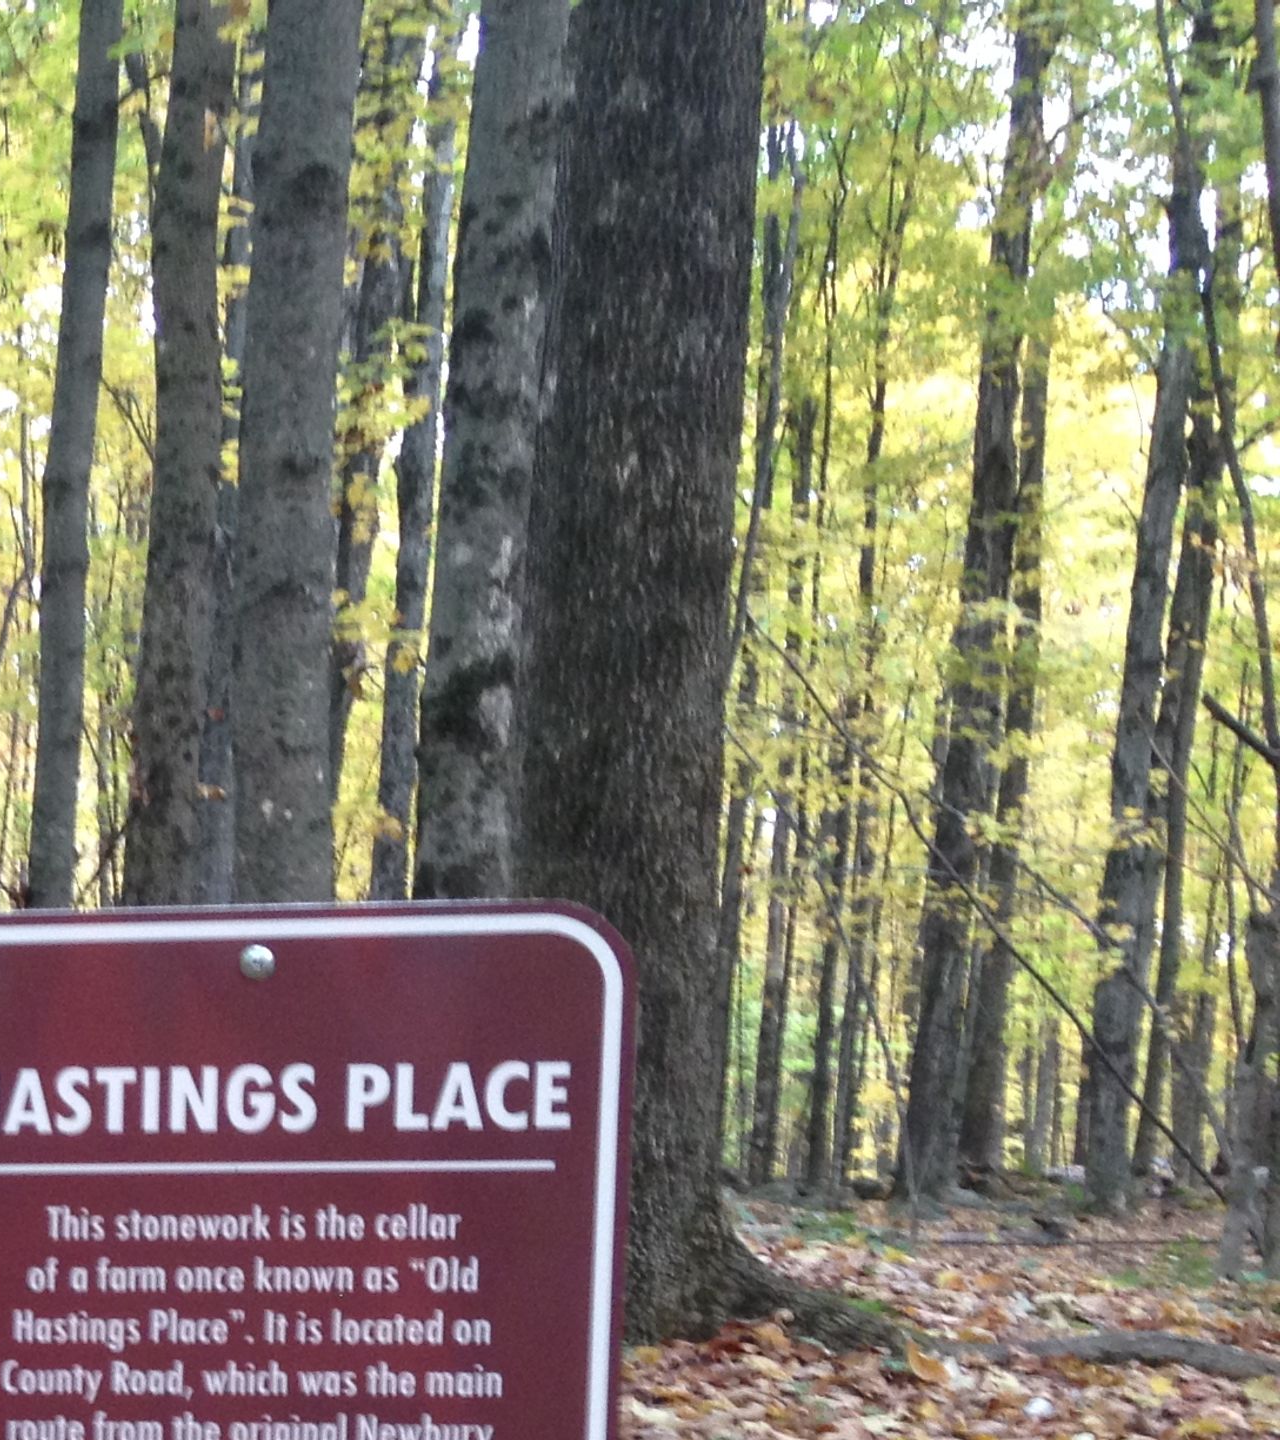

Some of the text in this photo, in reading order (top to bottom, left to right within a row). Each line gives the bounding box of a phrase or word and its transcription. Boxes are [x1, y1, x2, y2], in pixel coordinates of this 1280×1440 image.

[346, 1060, 571, 1132] PLACE
[46, 1203, 462, 1241] This stonework is the cellar
[27, 1256, 59, 1293] of
[69, 1266, 89, 1293] a
[96, 1256, 167, 1293] farm
[175, 1266, 245, 1293] once
[254, 1256, 354, 1293] known
[363, 1266, 400, 1293] as
[13, 1308, 141, 1353] Hastings
[264, 1309, 289, 1344] It
[295, 1311, 323, 1345] is
[332, 1308, 444, 1345] located
[452, 1318, 492, 1345] on
[0, 1359, 503, 1404] County Road, which was the main
